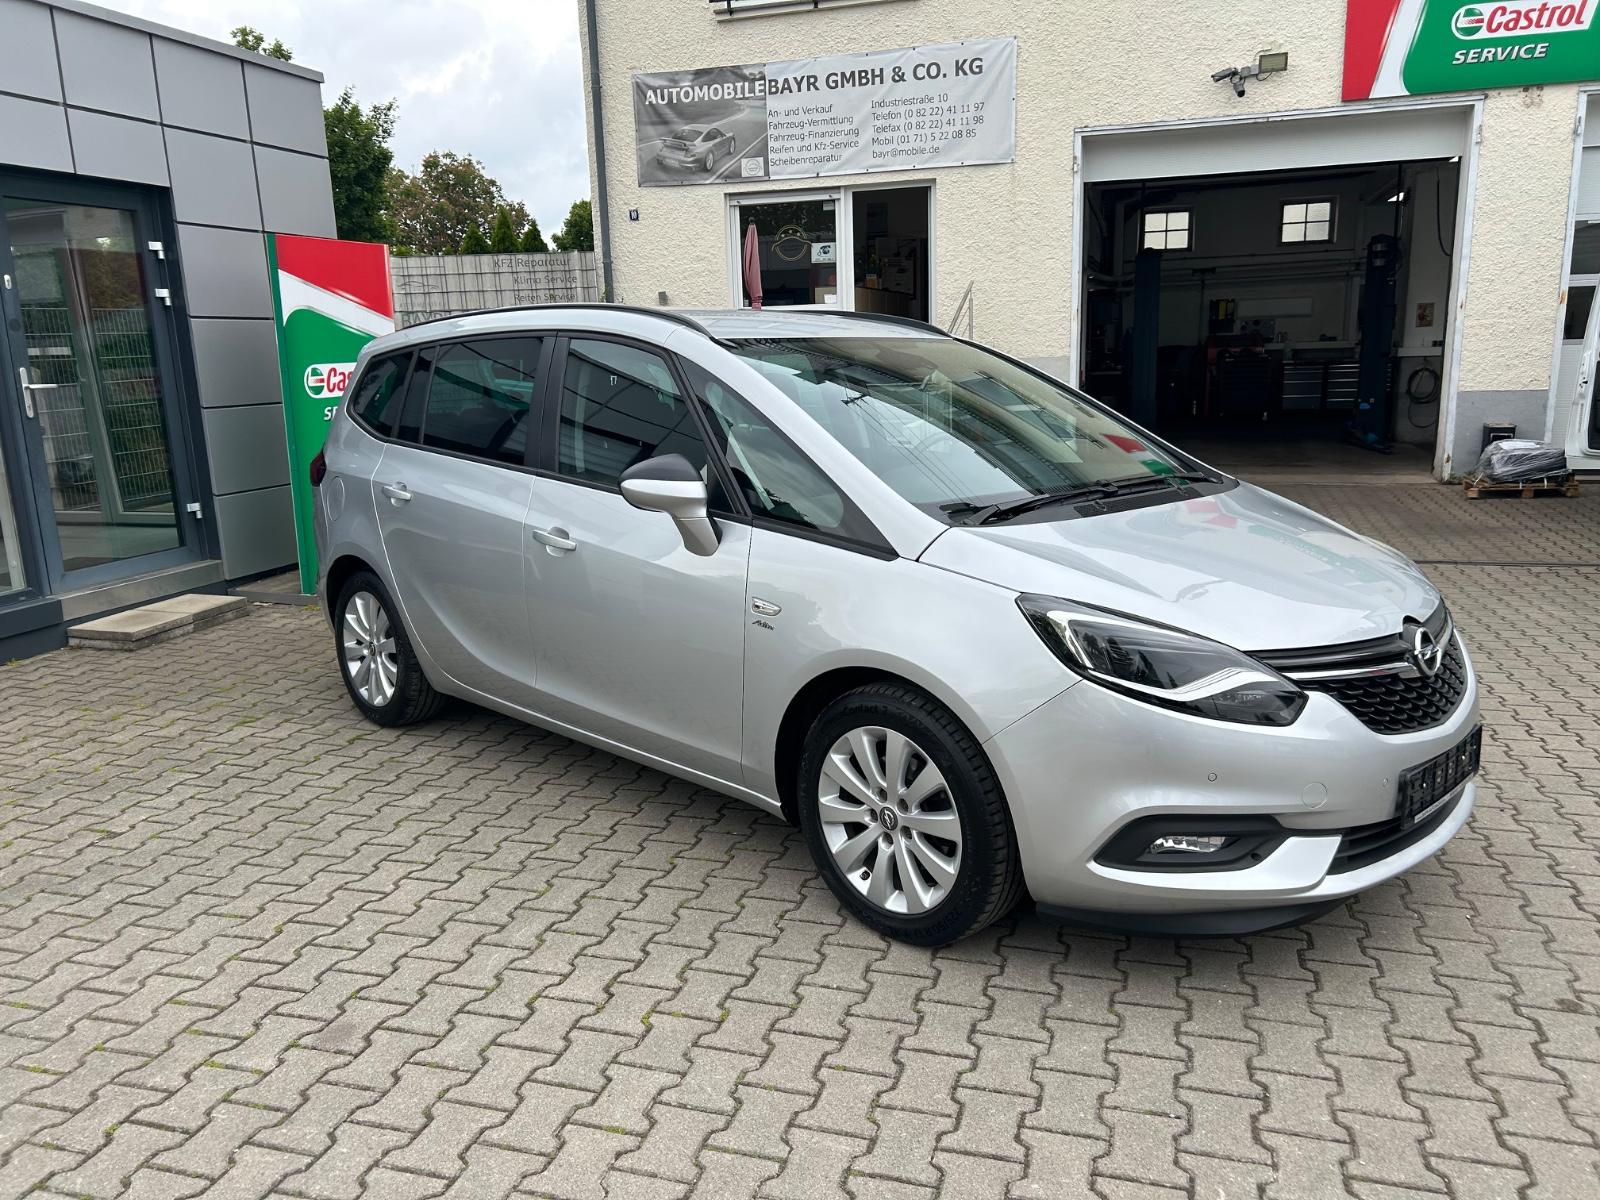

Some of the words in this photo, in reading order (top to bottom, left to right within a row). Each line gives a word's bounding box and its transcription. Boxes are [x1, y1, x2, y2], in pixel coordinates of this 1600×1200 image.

[1486, 0, 1586, 33] Castrol
[1452, 43, 1549, 65] SERVICE
[645, 80, 765, 105] AUTOMOBILE
[768, 74, 819, 96] BAYR
[825, 68, 884, 90] GMBH
[891, 65, 907, 84] &
[912, 61, 947, 81] CO.
[954, 57, 983, 77] KG
[871, 94, 934, 109] Industriestraße
[938, 93, 949, 102] 10
[768, 109, 781, 118] An-
[784, 107, 800, 117] und
[801, 104, 833, 115] Verkauf
[872, 110, 901, 121] Telefon
[904, 108, 913, 120] (0
[916, 108, 926, 117] 82
[929, 106, 944, 118] 22)
[947, 105, 957, 114] 41
[960, 104, 970, 113] 11
[973, 102, 985, 112] 97
[768, 116, 854, 131] Fahrzeug-Vermittlung
[873, 123, 900, 134] Telefax
[904, 121, 913, 133] (0
[916, 121, 926, 130] 82
[929, 119, 943, 131] 22)
[946, 118, 956, 127] 41
[960, 117, 969, 126] 11
[973, 115, 984, 125] 98
[769, 127, 860, 143] Fahrzeug-Finanzierung
[872, 135, 894, 146] Mobil
[897, 134, 910, 146] (01
[914, 132, 928, 144] 71)
[931, 132, 936, 142] 5
[939, 131, 949, 141] 22
[952, 130, 963, 139] 08
[966, 129, 977, 138] 85
[769, 144, 795, 155] Reifen
[797, 143, 812, 153] und
[814, 140, 859, 151] Kfz-Service
[872, 145, 940, 160] bayr@mobile.de
[770, 154, 842, 167] Scheibenreparatur
[494, 258, 513, 268] KFZ
[517, 257, 569, 269] Reparatur
[544, 274, 577, 284] Service
